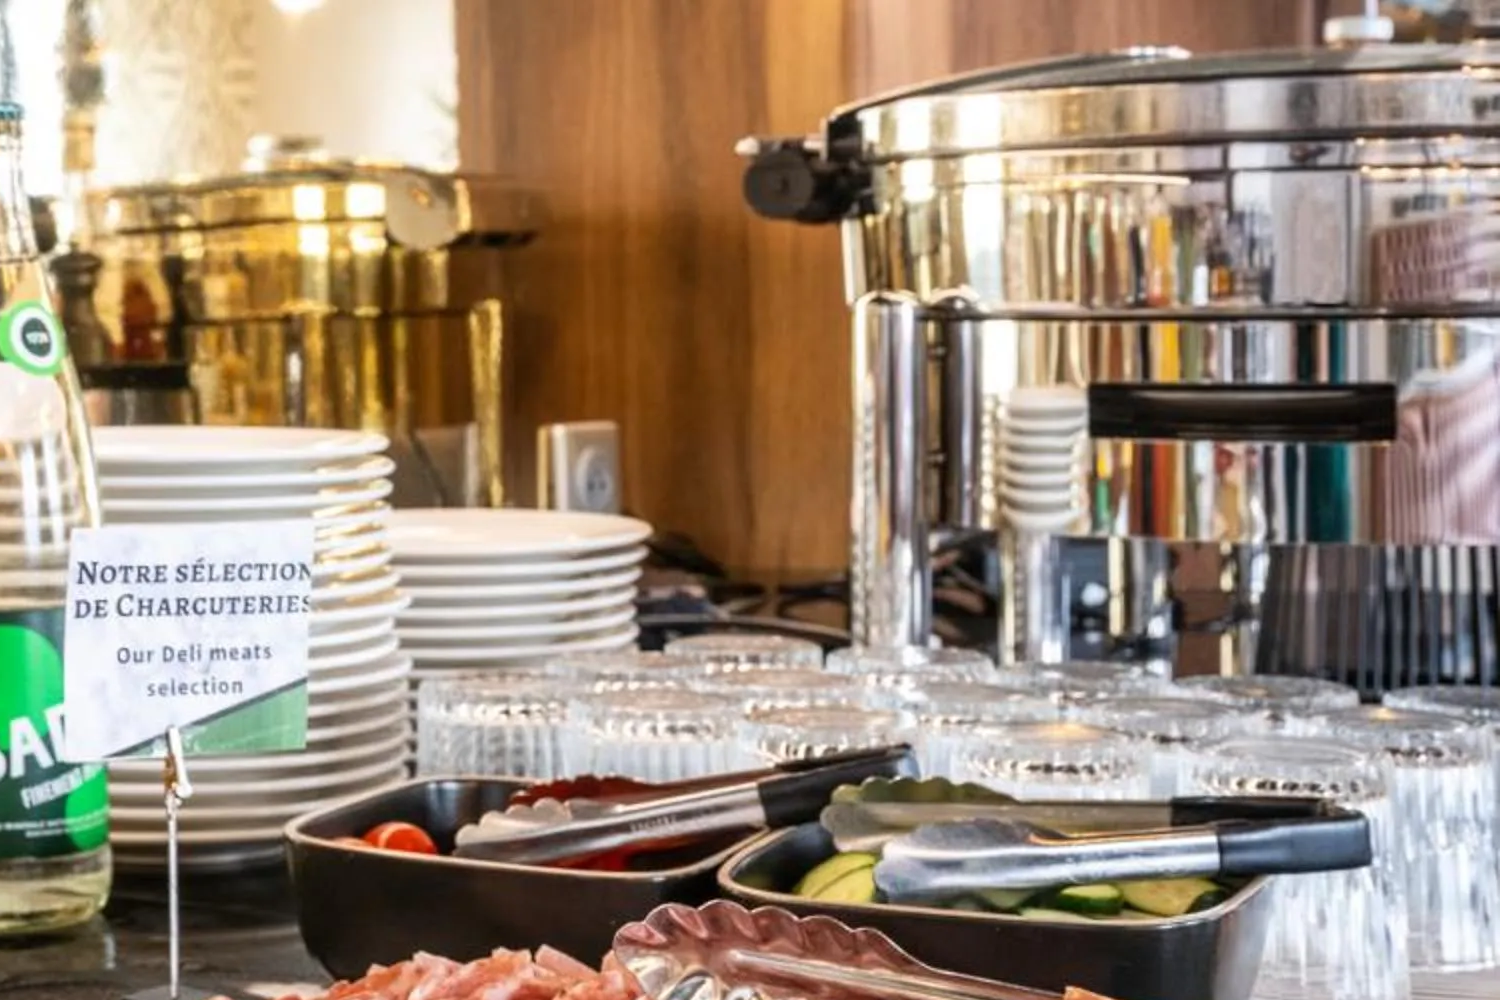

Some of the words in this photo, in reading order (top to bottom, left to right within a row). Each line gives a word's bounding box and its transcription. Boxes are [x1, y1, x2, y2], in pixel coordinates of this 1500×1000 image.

[74, 599, 108, 619] DE
[117, 647, 154, 664] Our
[162, 643, 202, 663] Deli
[210, 644, 273, 662] meats
[147, 676, 243, 697] selection
